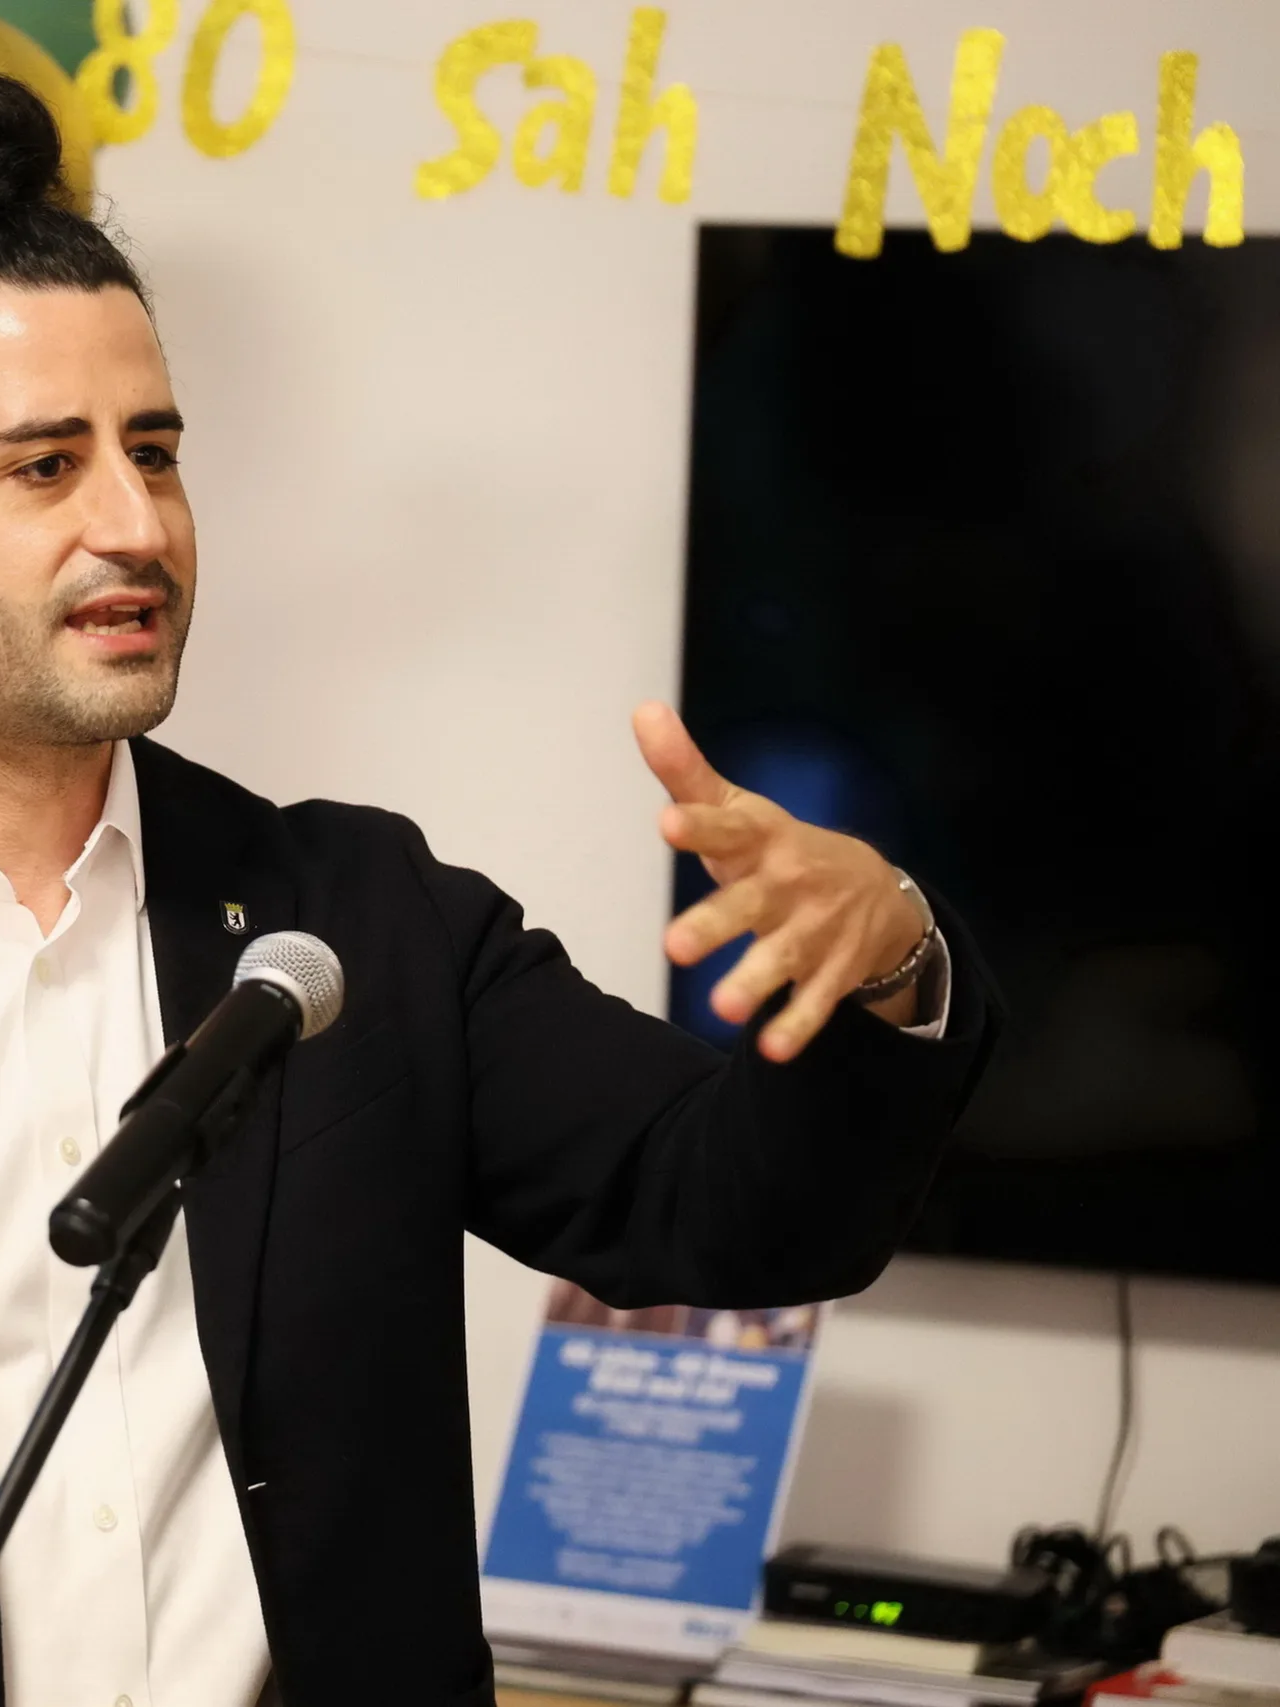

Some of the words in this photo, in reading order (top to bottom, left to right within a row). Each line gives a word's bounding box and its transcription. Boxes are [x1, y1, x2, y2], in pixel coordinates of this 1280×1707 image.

[76, 0, 297, 160] 80
[414, 6, 698, 204] Sah
[834, 27, 1246, 259] Noch
